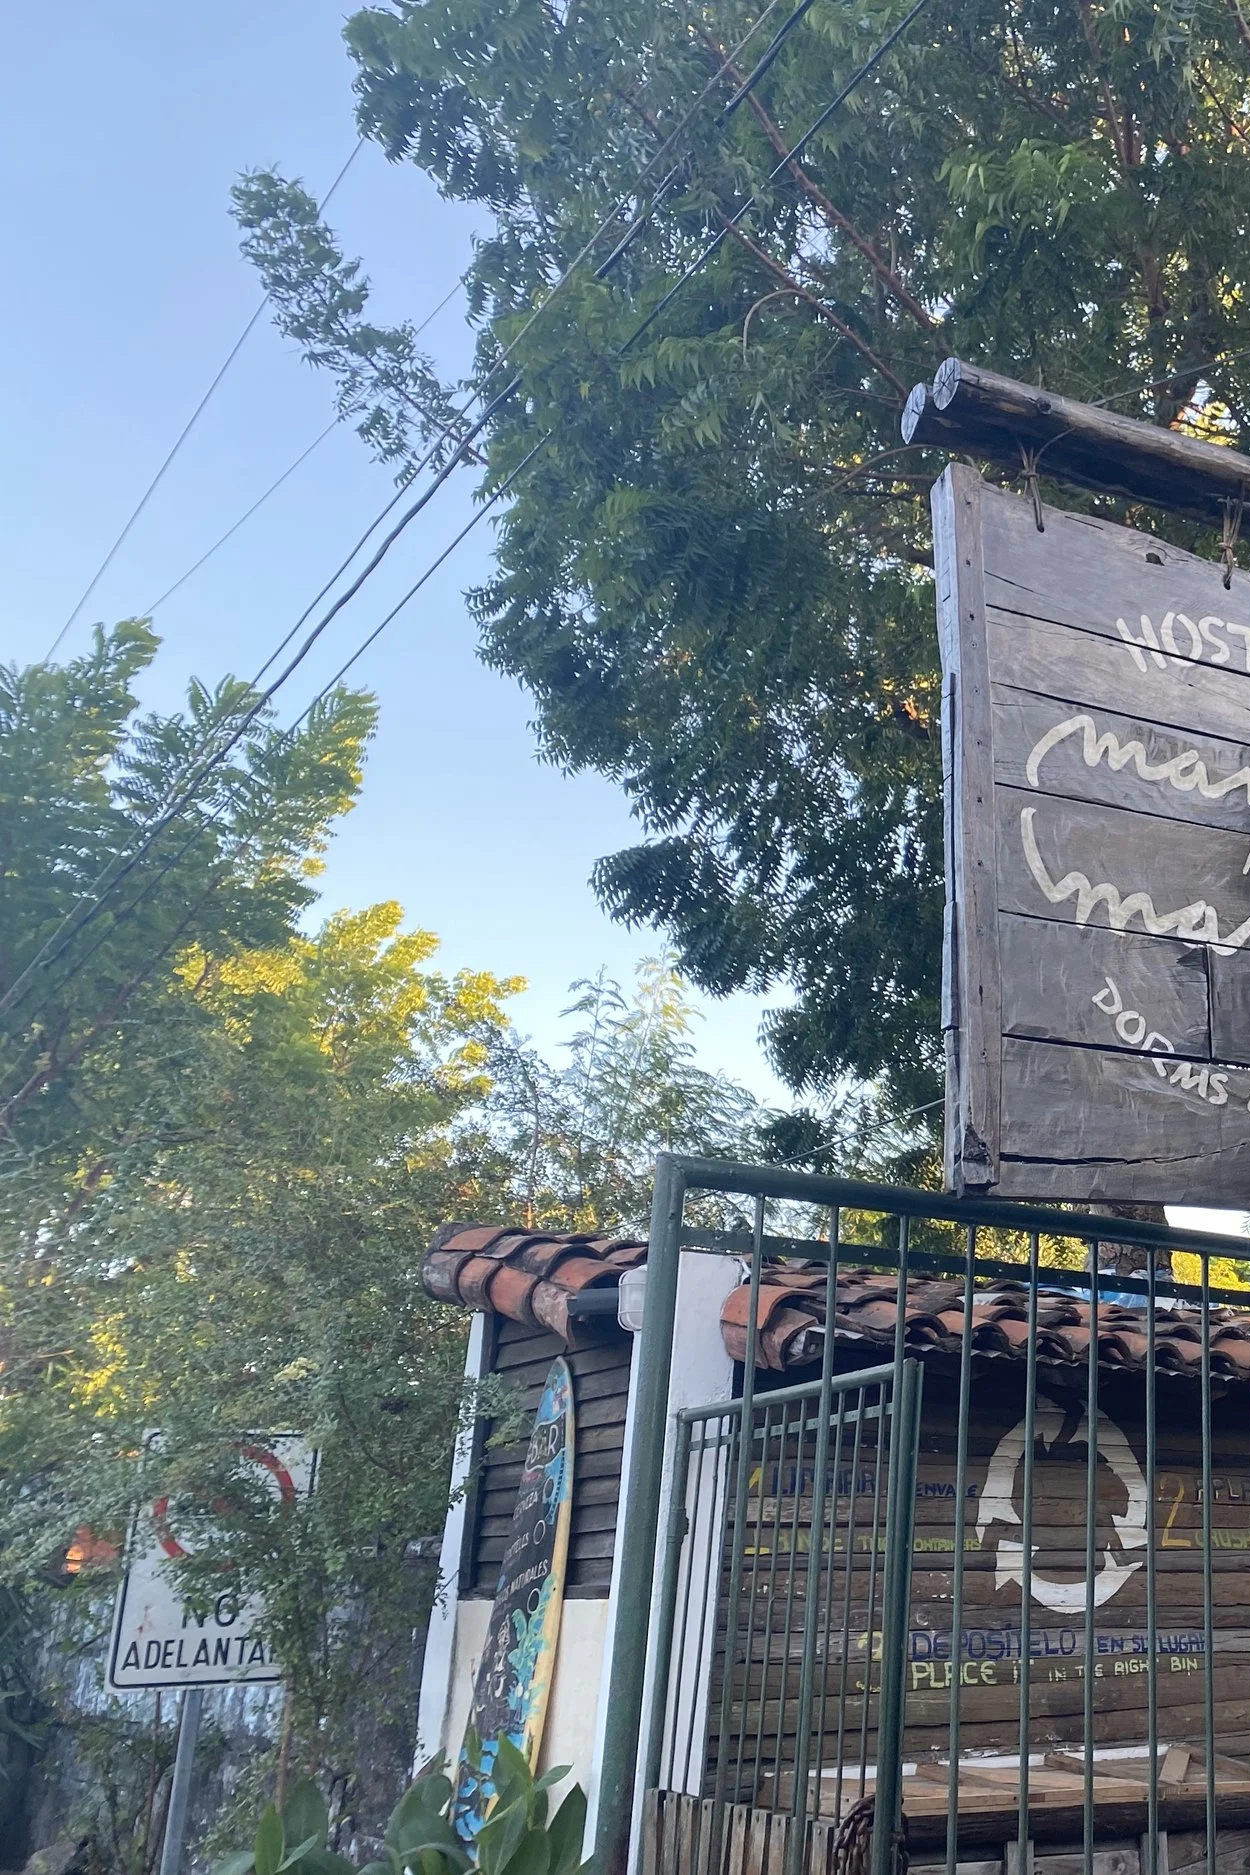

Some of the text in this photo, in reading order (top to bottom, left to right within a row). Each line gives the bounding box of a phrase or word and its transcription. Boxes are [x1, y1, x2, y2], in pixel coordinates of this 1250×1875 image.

[1091, 977, 1229, 1106] DORMS
[915, 1482, 978, 1498] ENVAE
[1160, 1475, 1191, 1547] 2
[1097, 1635, 1125, 1653] EN
[910, 1660, 998, 1690] PLACE
[1074, 1663, 1104, 1678] TE
[1169, 1657, 1199, 1675] BIN
